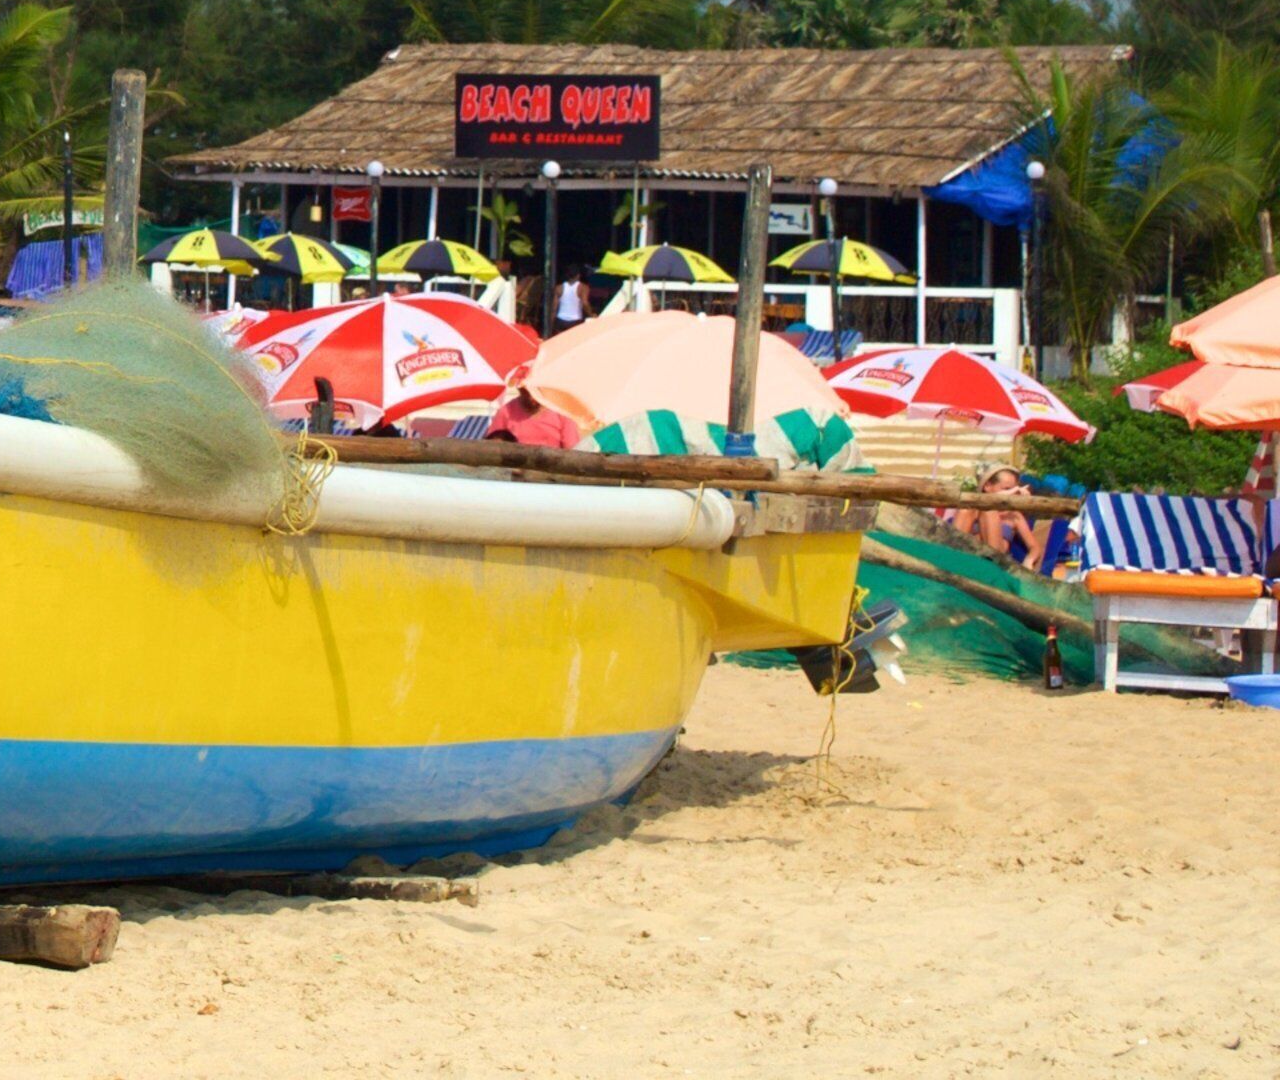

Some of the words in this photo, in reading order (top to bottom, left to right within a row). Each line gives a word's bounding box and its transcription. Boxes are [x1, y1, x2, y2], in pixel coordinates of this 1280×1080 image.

[460, 84, 552, 123] BEACH
[560, 84, 652, 129] QUEEN
[489, 132, 517, 144] BAR
[536, 132, 623, 145] RESTAURANT
[397, 351, 462, 377] KINGFISHER
